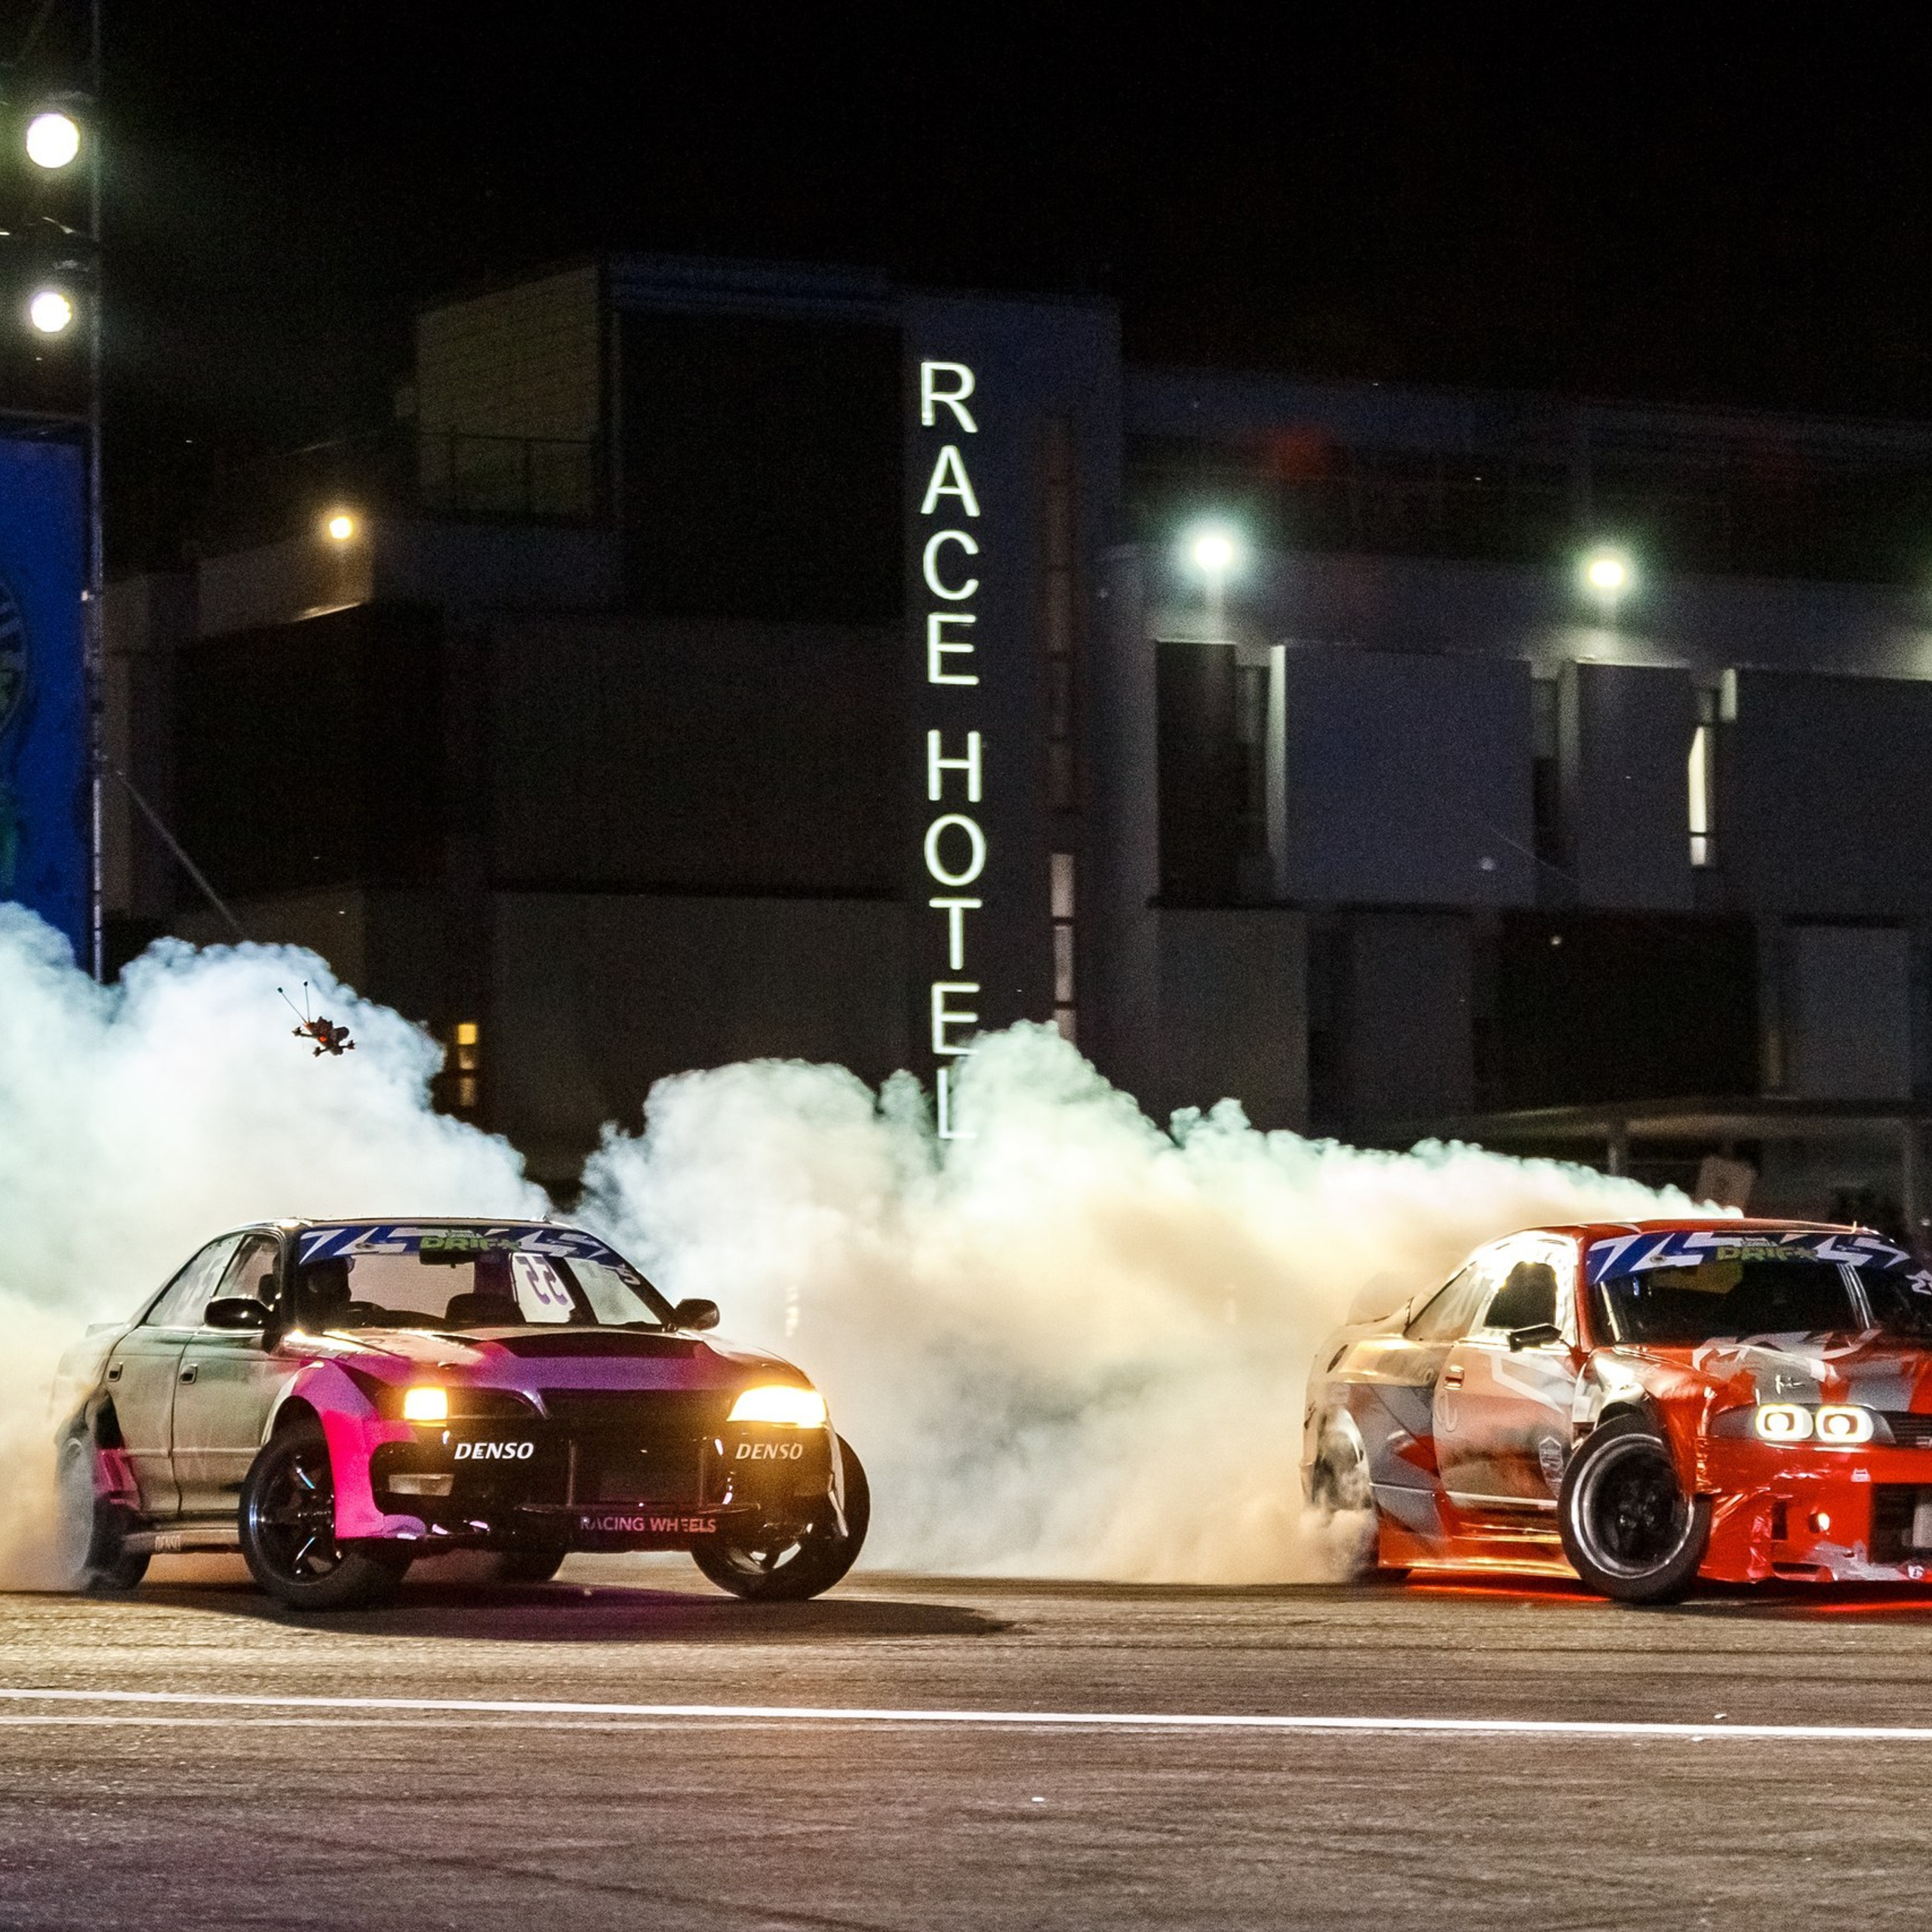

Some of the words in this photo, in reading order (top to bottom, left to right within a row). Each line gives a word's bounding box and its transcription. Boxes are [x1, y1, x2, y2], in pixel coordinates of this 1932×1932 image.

[921, 361, 981, 685] RACE
[924, 729, 986, 1140] HOTEL
[454, 1442, 534, 1460] DENSO
[735, 1442, 803, 1460] DENSO
[580, 1516, 645, 1531] RACING
[650, 1518, 717, 1533] WHEELS
